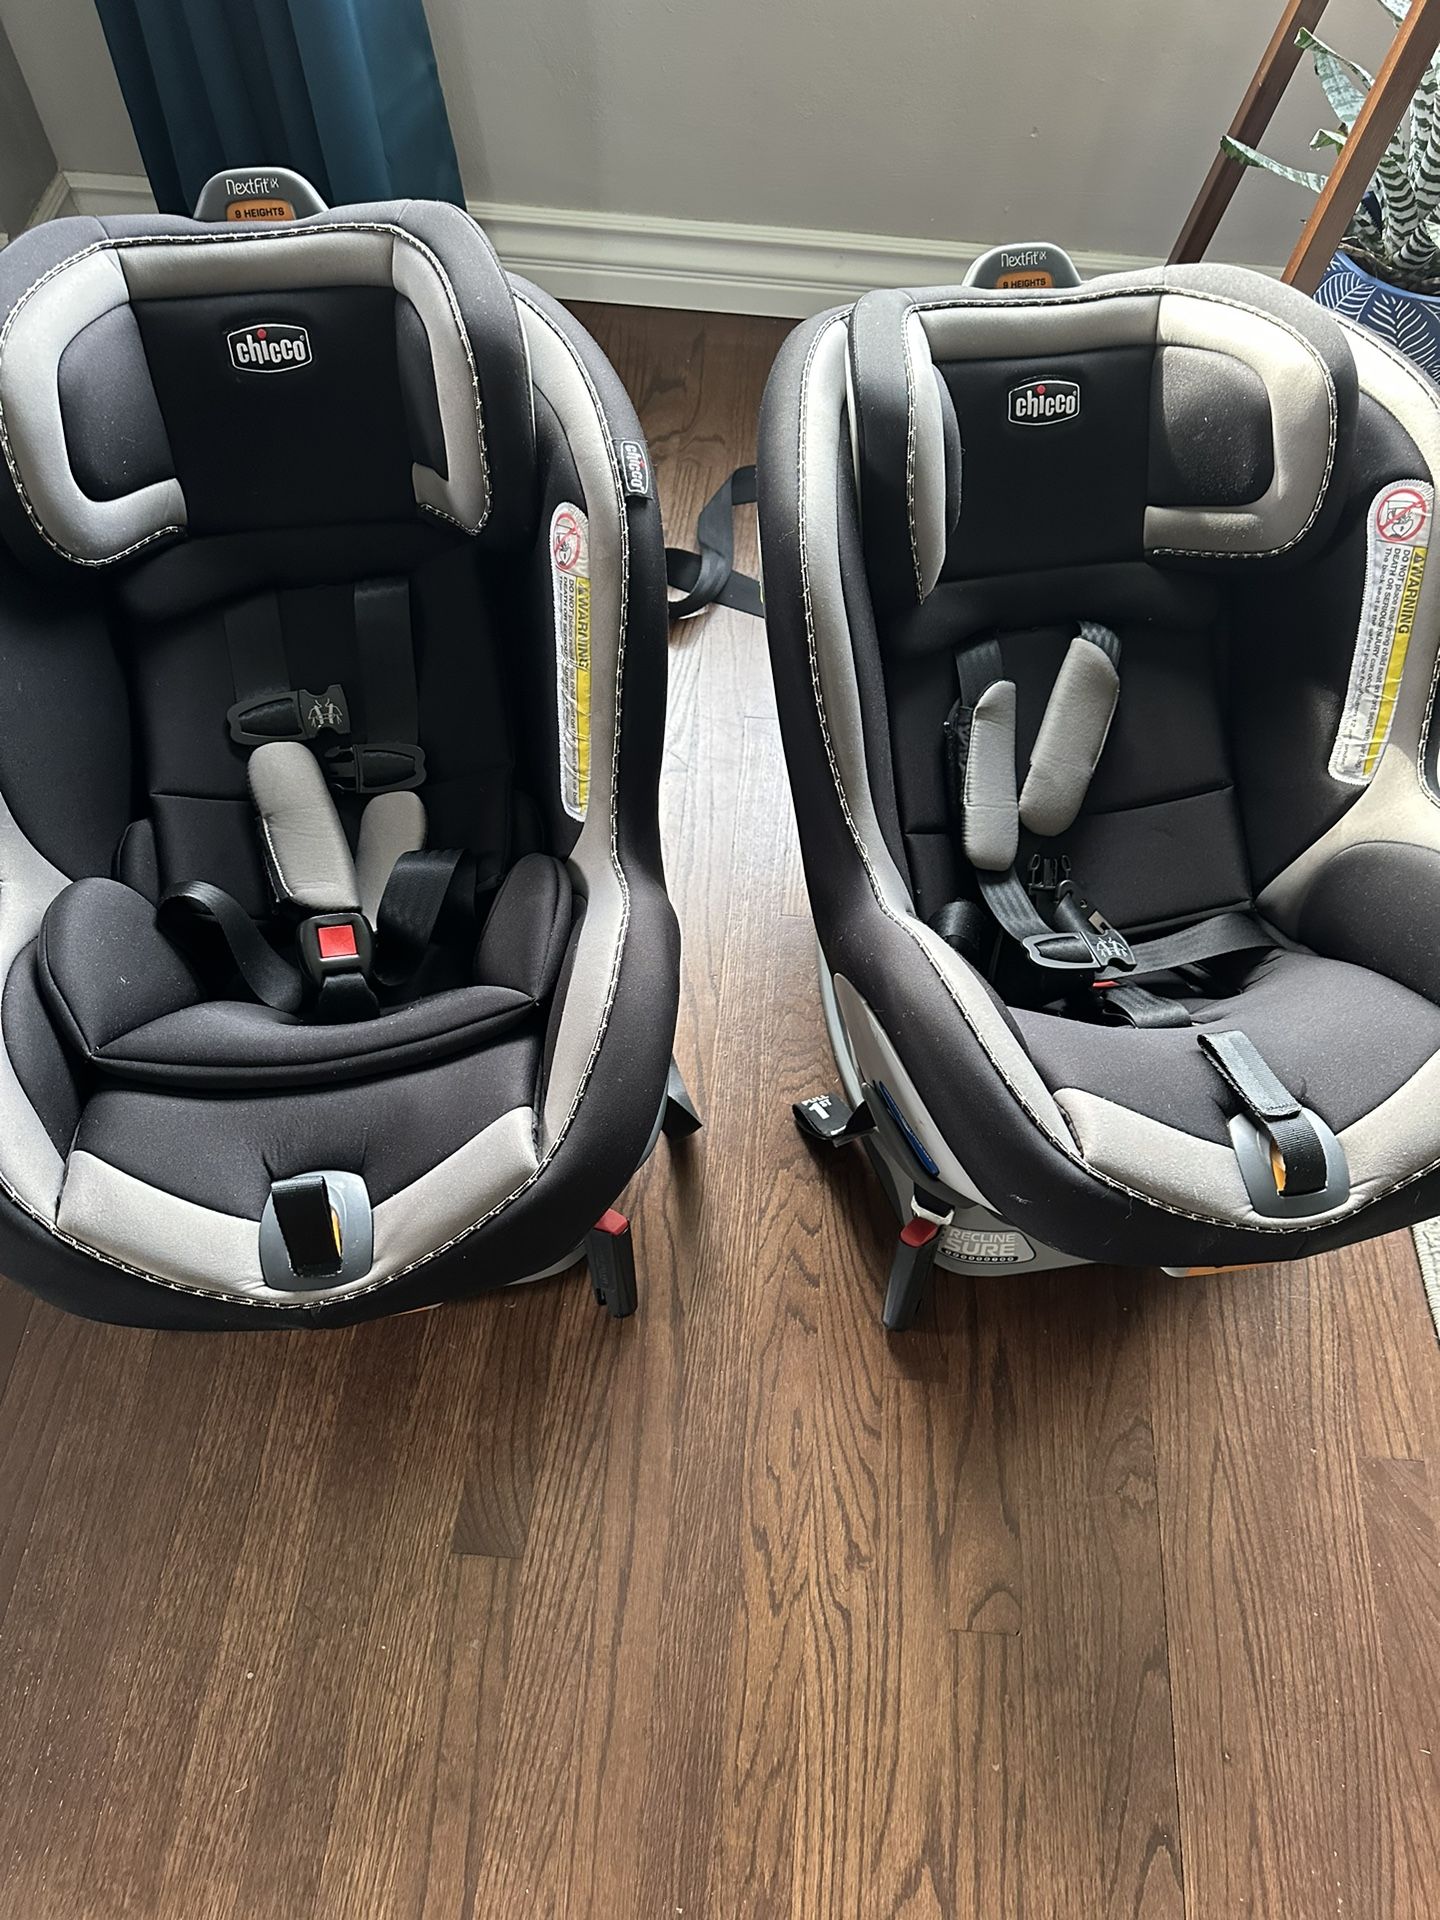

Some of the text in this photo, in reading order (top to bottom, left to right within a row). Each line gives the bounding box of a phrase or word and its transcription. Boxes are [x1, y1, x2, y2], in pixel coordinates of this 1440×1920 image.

[234, 207, 285, 219] 9 HEIGHTS
[1011, 278, 1046, 288] HEIGHTS
[236, 328, 306, 364] chicco
[1015, 384, 1076, 417] chicco
[625, 445, 644, 488] chicco
[1384, 547, 1392, 563] The
[1391, 548, 1402, 576] DEATH
[1401, 549, 1410, 562] DO
[1398, 564, 1408, 582] NOT
[568, 579, 574, 593] DO
[1385, 577, 1394, 590] OR
[1392, 584, 1402, 605] place
[1398, 564, 1422, 634] WARNING
[1378, 591, 1392, 629] SERIOUS
[578, 596, 590, 669] WARNING
[949, 1228, 1016, 1243] RECLINE
[944, 1237, 1015, 1256] SURE
